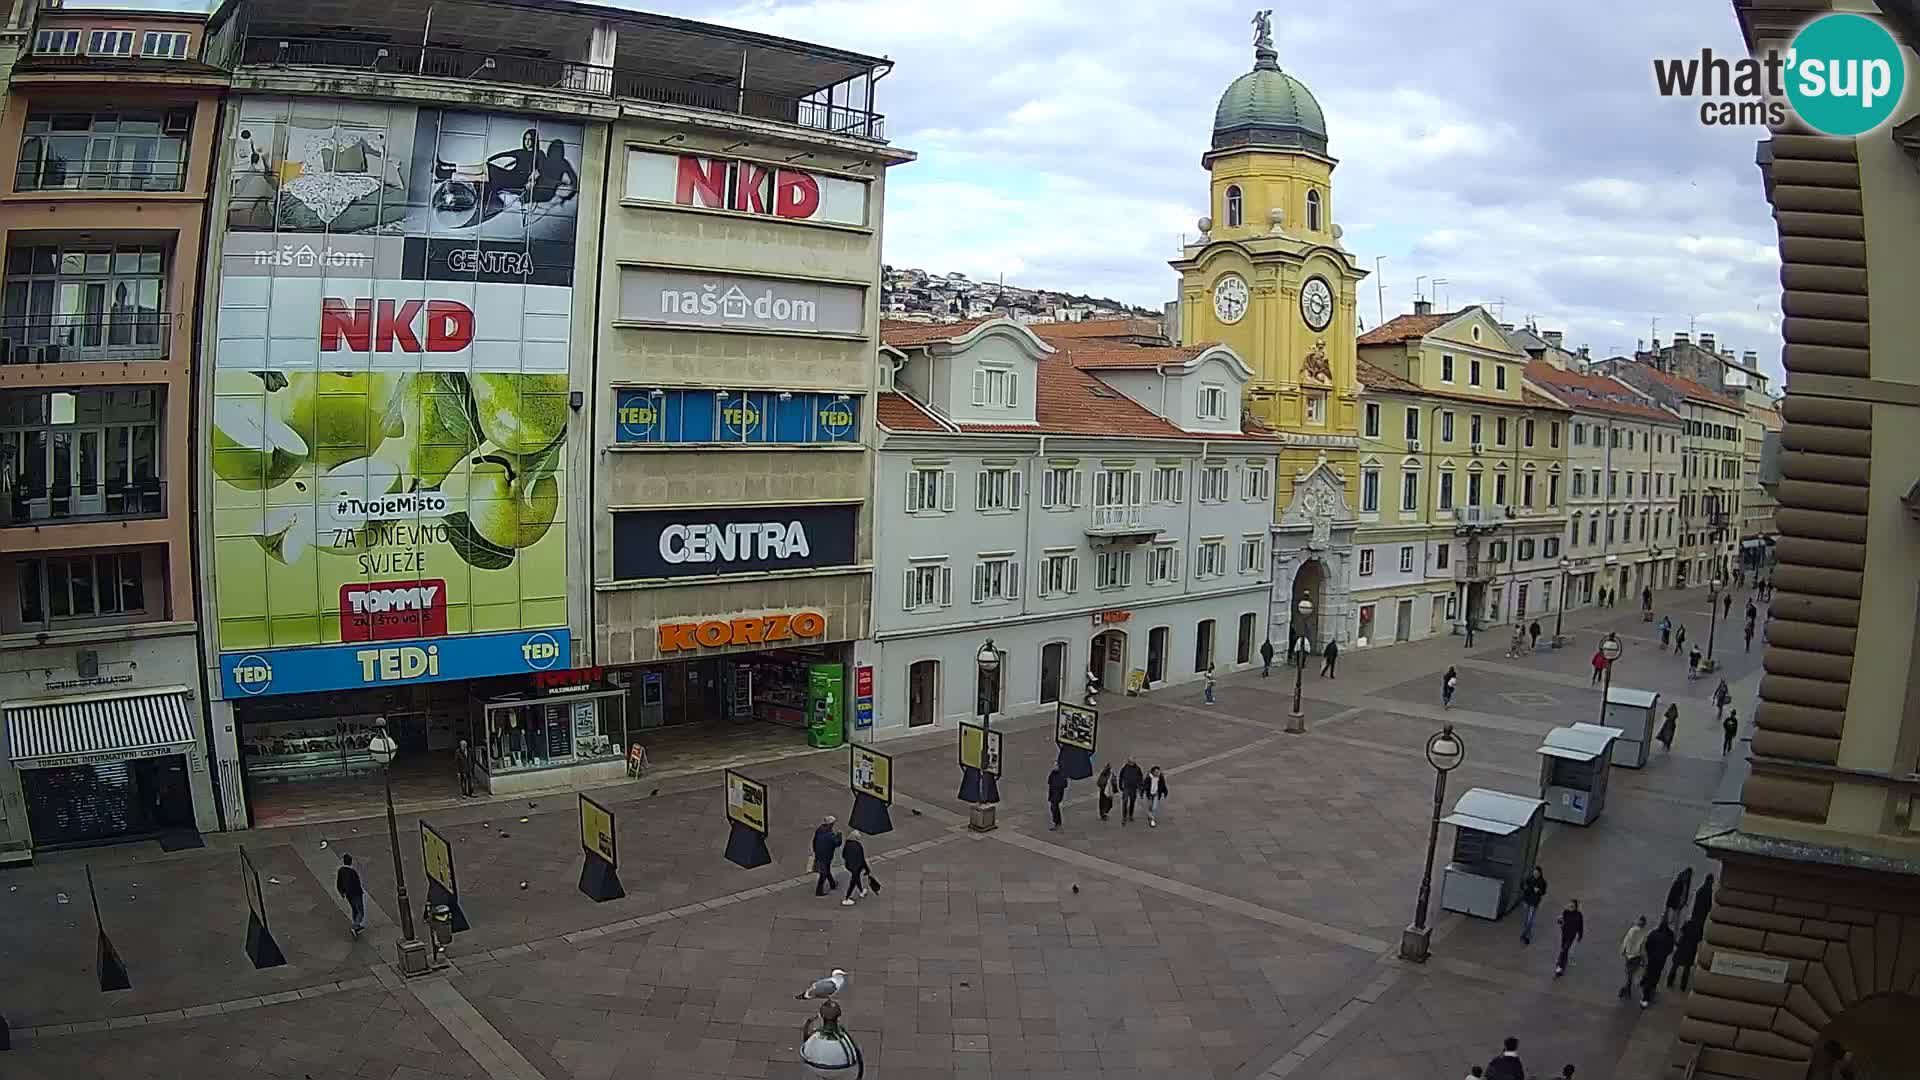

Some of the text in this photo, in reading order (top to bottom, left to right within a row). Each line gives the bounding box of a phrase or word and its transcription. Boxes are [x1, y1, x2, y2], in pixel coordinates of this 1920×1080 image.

[675, 155, 820, 218] NKD
[254, 245, 365, 267] naš dom
[447, 249, 534, 275] CENTRA
[661, 284, 816, 322] naš dom
[320, 297, 476, 353] NKD
[618, 408, 657, 425] TEDi
[723, 408, 760, 425] TEDi
[819, 411, 853, 426] TEDi
[337, 496, 446, 516] #TvojeMisto
[333, 523, 450, 548] ZA DNEVNO
[659, 521, 810, 563] CENTRA
[358, 547, 425, 575] SVJEŽE
[348, 586, 439, 614] TOMMY
[658, 611, 826, 652] KORZO
[357, 645, 439, 681] TEDi
[521, 641, 559, 660] TEDi
[233, 666, 272, 684] TEDi
